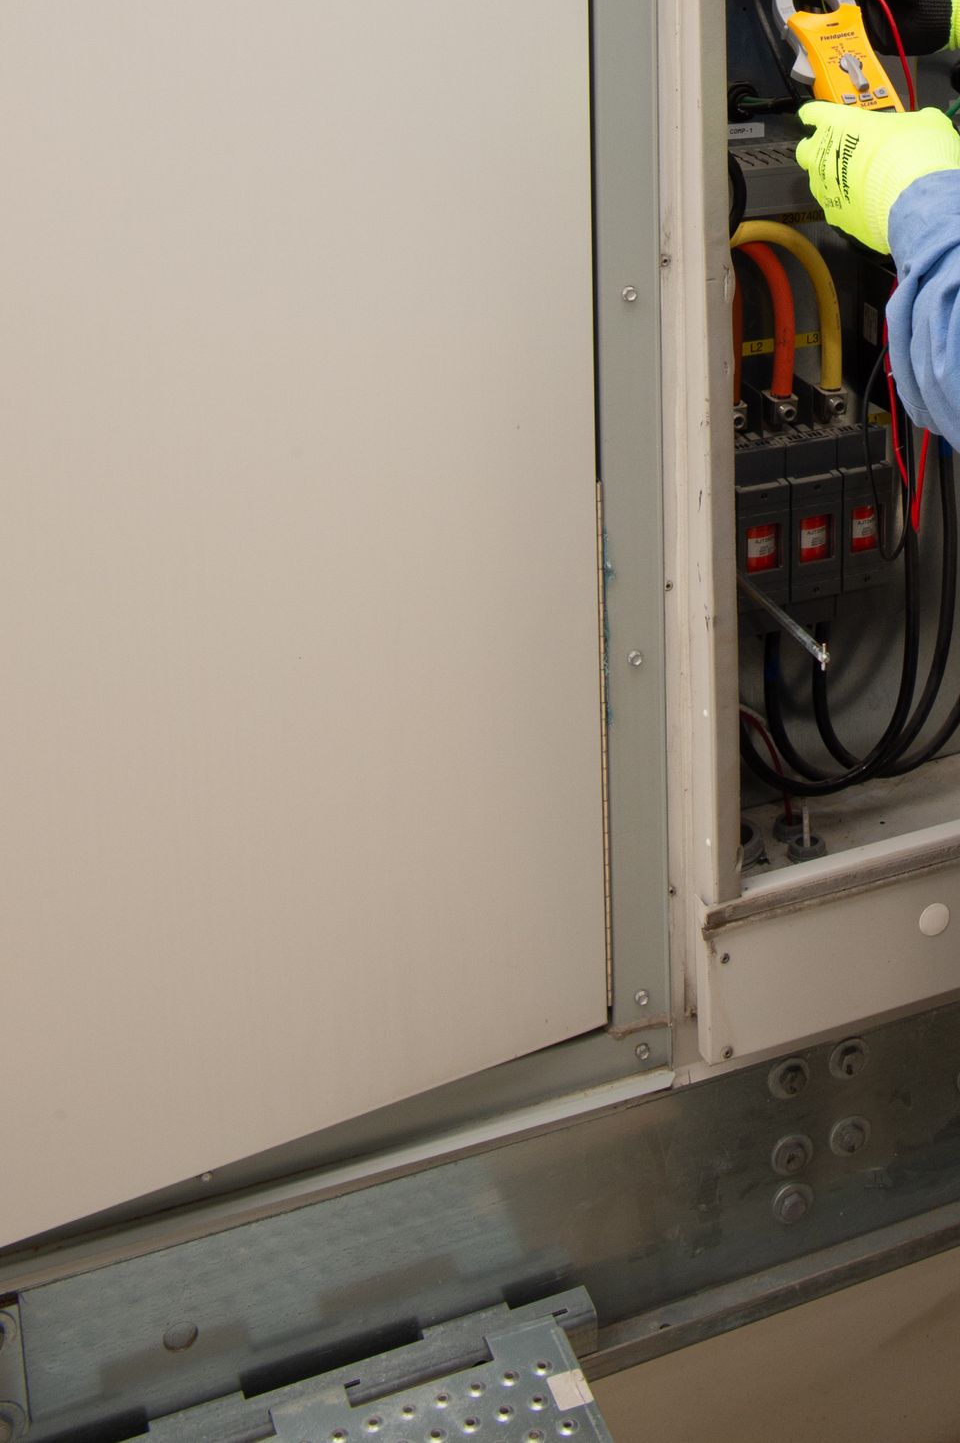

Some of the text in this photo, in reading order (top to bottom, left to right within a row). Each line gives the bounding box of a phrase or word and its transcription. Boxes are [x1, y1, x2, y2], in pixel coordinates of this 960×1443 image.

[820, 31, 855, 41] Fieldpiece
[842, 134, 860, 204] Milwaukee
[751, 334, 818, 352] L2 L3
